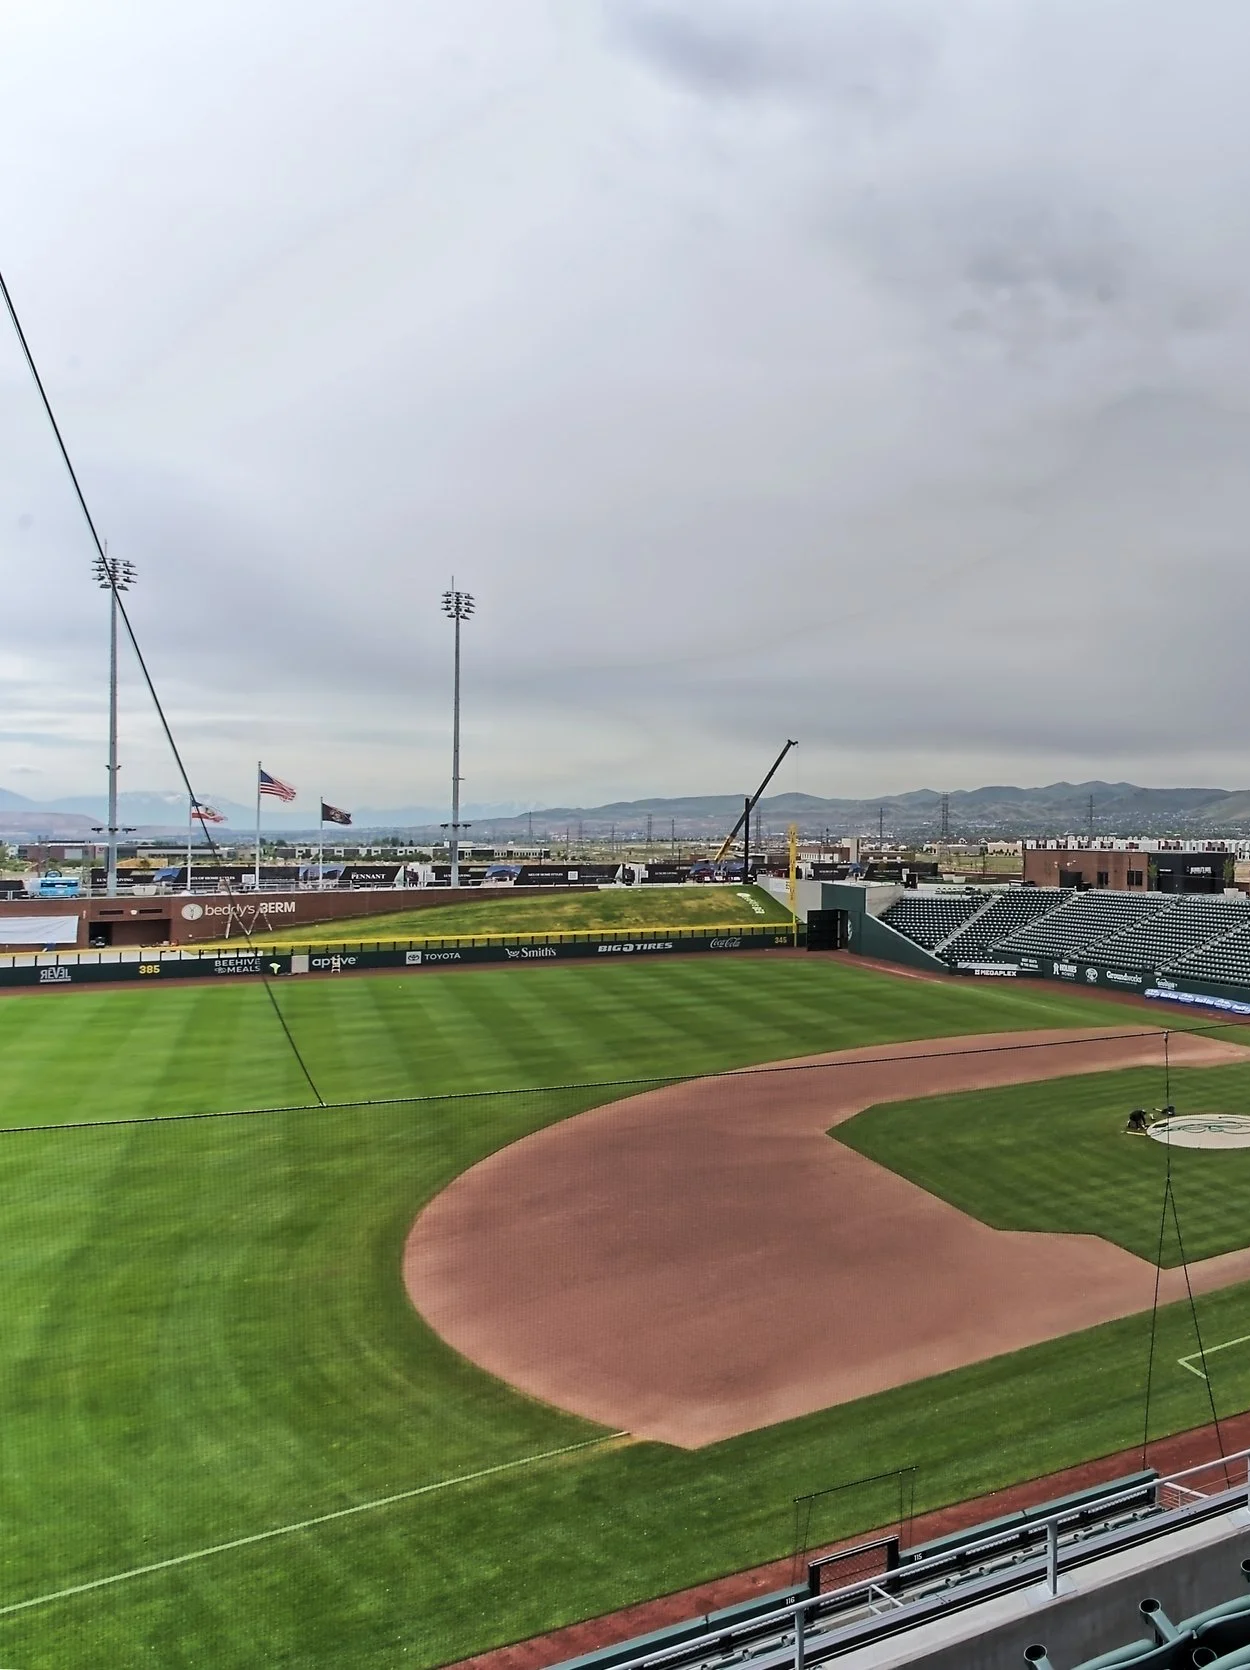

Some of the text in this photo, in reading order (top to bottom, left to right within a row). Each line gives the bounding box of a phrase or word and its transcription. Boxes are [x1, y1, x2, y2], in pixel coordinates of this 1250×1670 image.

[351, 872, 387, 880] PENNANT
[259, 901, 296, 914] BERM
[774, 936, 788, 945] 345
[598, 944, 622, 952] BIG
[635, 942, 673, 950] TIRES
[424, 951, 461, 960] TOYOTA
[520, 947, 557, 959] Smith's
[214, 957, 261, 967] BEEHIVE
[138, 964, 161, 975] 385
[226, 965, 261, 974] MEALS
[980, 969, 1017, 977] MEGAPLEX
[913, 1552, 923, 1562] 115
[785, 1596, 796, 1606] 116
